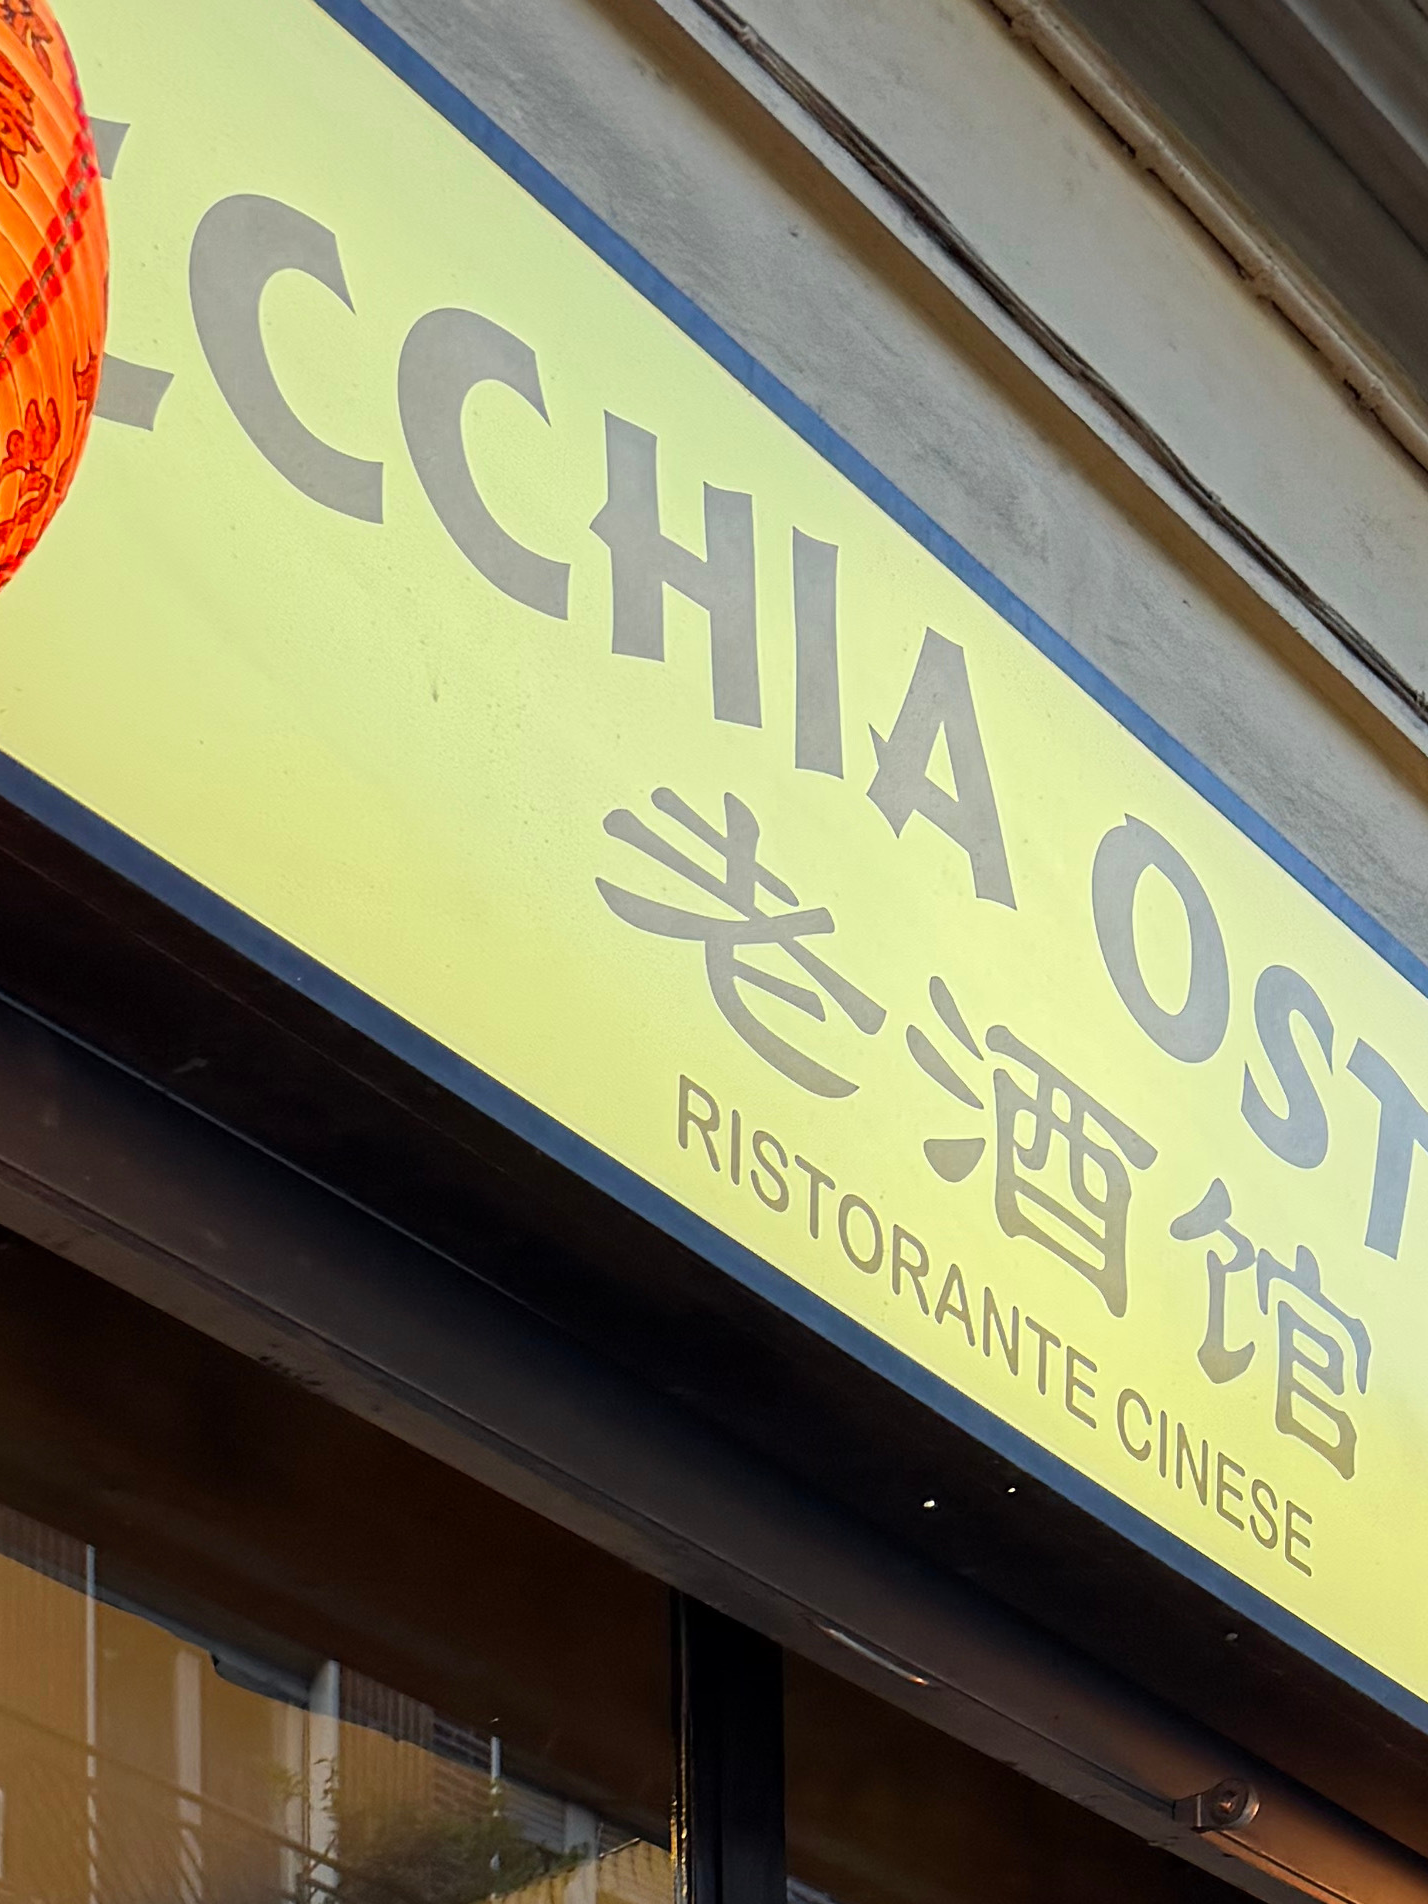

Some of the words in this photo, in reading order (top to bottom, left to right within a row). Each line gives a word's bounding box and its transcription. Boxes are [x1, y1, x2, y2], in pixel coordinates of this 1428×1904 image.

[89, 117, 1018, 910] CCHIA
[594, 781, 1375, 1484] 老酒馆
[673, 1070, 1099, 1433] RISTORANTE
[1114, 1383, 1317, 1578] CINESE
